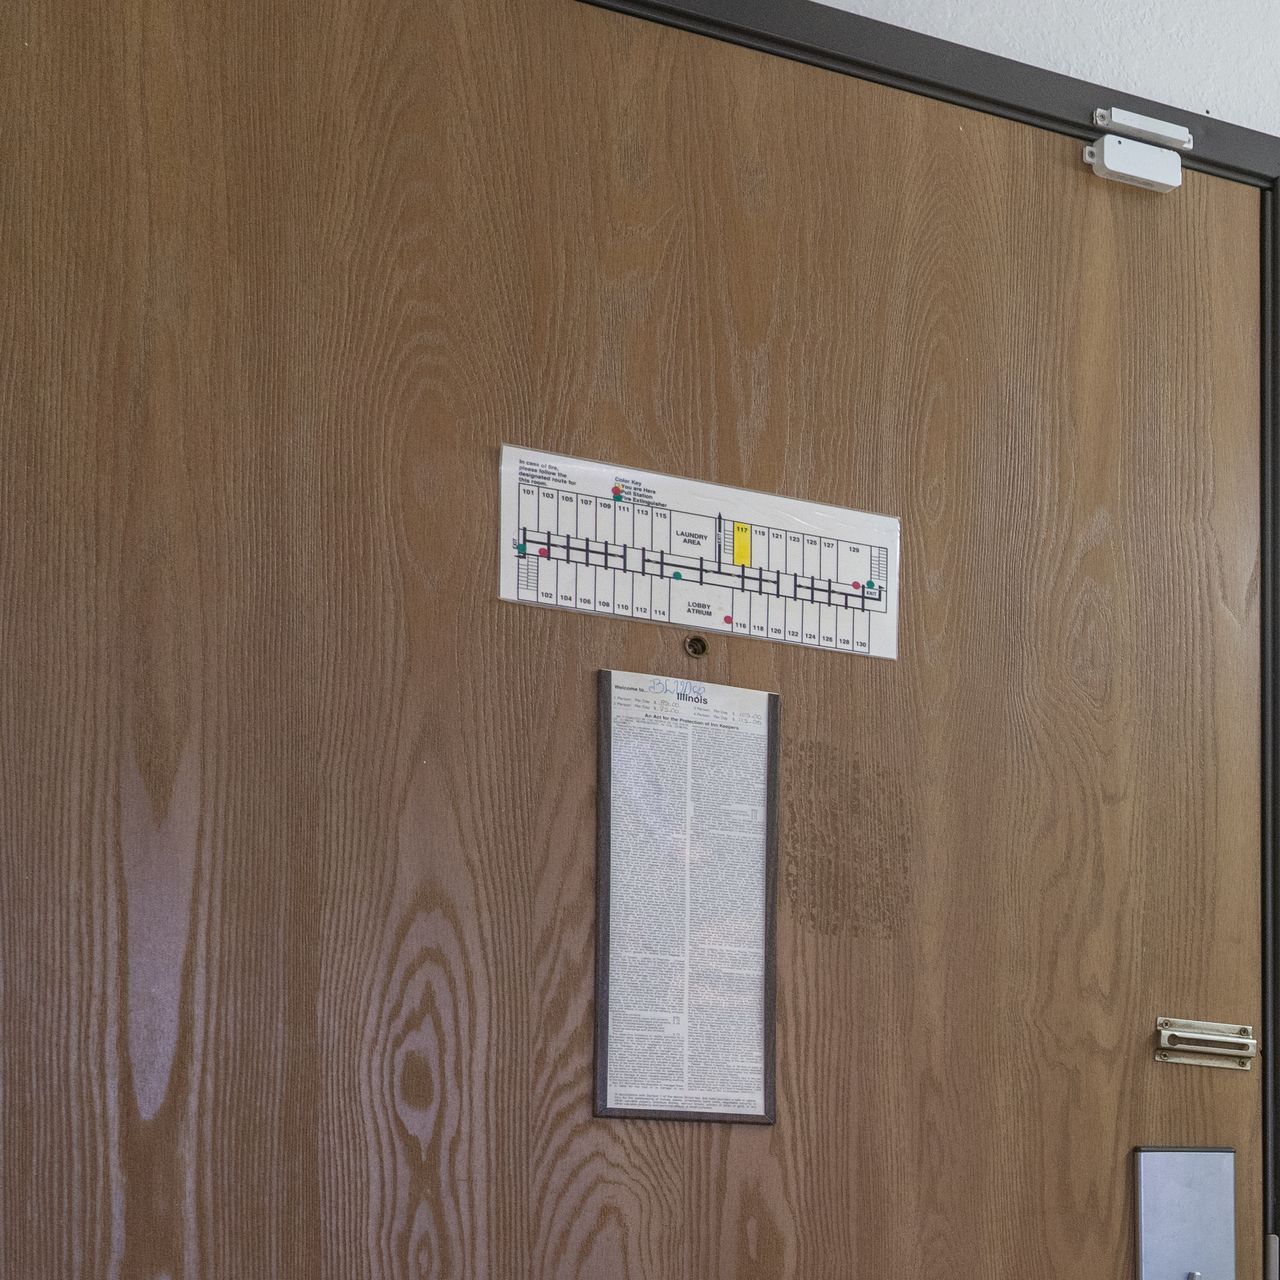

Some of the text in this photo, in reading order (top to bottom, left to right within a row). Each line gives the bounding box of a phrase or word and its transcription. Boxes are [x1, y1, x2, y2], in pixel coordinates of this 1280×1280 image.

[519, 472, 550, 480] designated
[633, 497, 667, 507] Extinguisher
[676, 530, 708, 541] LAUNDRY
[687, 608, 712, 616] ATRIUM
[677, 693, 708, 704] Illinois
